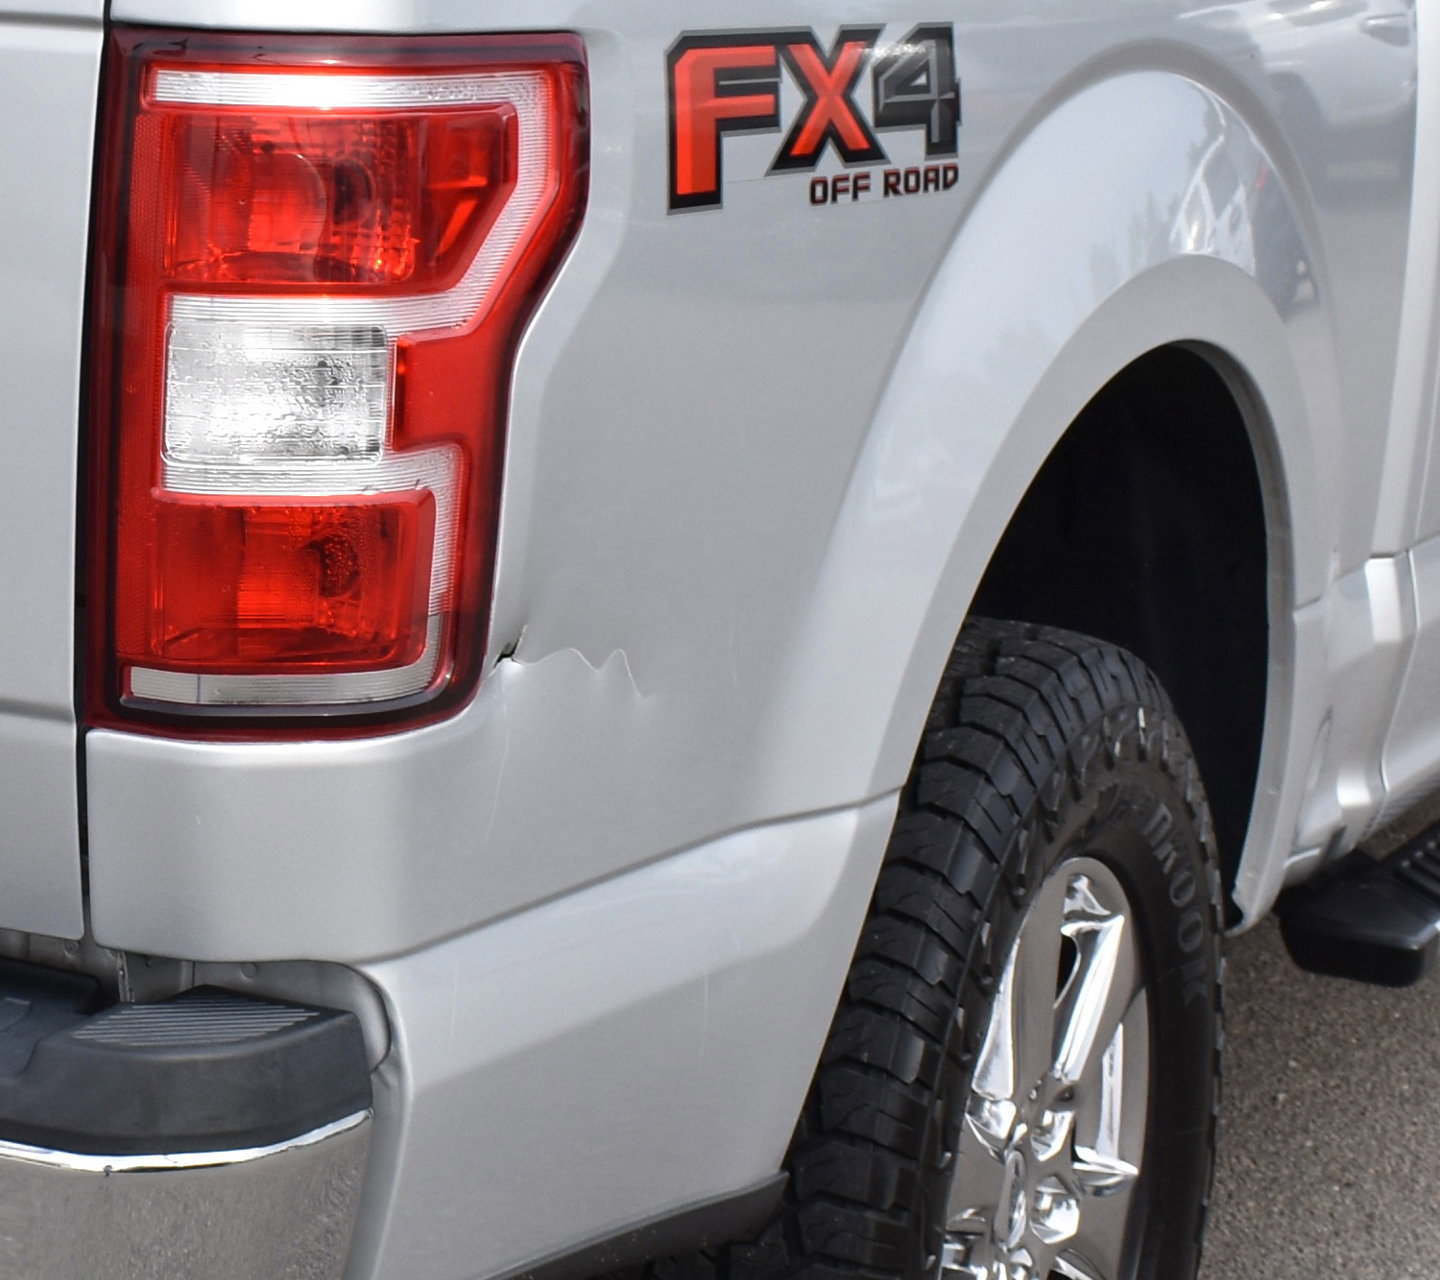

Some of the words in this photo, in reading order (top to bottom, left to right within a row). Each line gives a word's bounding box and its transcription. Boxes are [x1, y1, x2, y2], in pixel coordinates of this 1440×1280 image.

[664, 21, 961, 215] FX4
[810, 171, 872, 206] OFF
[883, 162, 960, 198] ROAD
